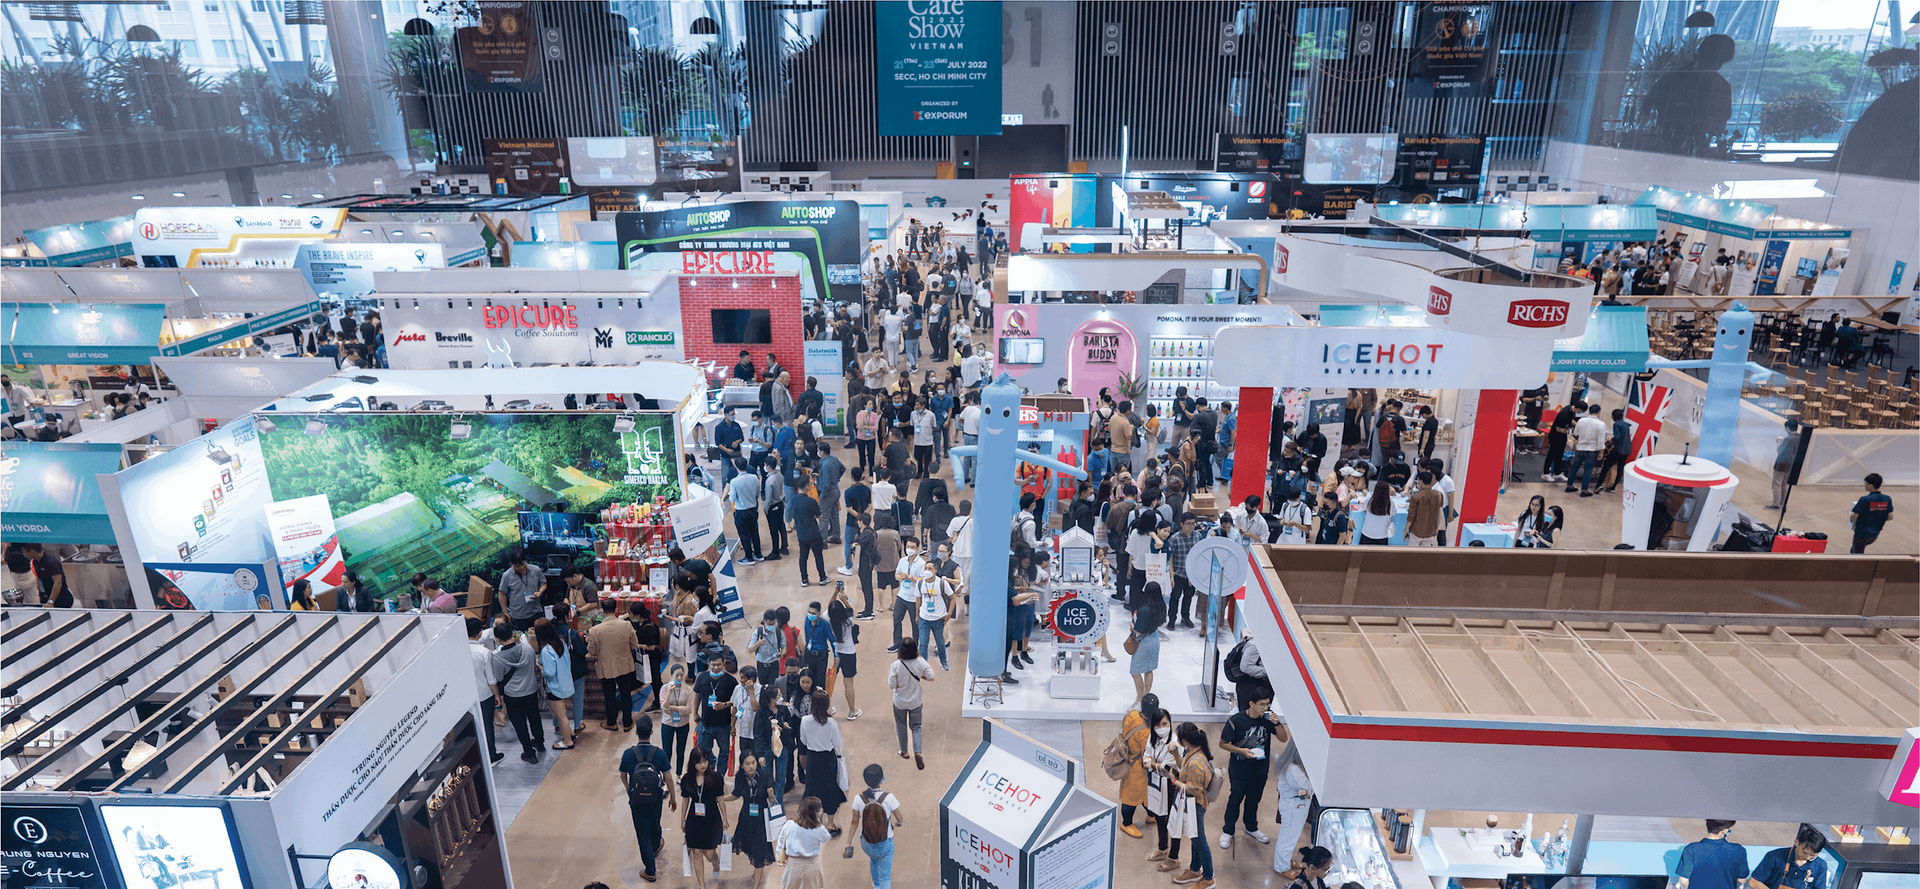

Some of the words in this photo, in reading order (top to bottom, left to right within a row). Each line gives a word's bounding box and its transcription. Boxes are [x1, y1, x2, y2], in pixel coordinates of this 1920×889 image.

[909, 16, 964, 38] Show
[948, 61, 965, 69] JULY
[894, 73, 917, 81] SECC,
[687, 209, 731, 227] AUTOSHOP
[781, 206, 836, 219] AUTOSHOP
[308, 250, 321, 261] THE
[323, 250, 345, 261] BRAVE
[346, 251, 374, 261] INSPIRE
[682, 251, 775, 274] EPICURE
[482, 305, 578, 329] EPICURE
[1512, 304, 1567, 322] RICH'S
[208, 334, 223, 342] MAULIN
[393, 330, 426, 346] jura
[435, 332, 473, 342] Breville
[514, 329, 541, 338] Coffee
[542, 328, 578, 337] Solutions
[638, 333, 673, 342] RANCILIO
[1084, 335, 1119, 347] BARISTA
[1088, 349, 1117, 360] BUDDY
[1322, 343, 1444, 364] ICEHOT
[1044, 411, 1073, 422] Mall
[234, 431, 255, 447] GOALS
[16, 525, 51, 533] YORDA
[1067, 608, 1087, 617] ICE
[1063, 617, 1090, 626] HOT
[397, 705, 418, 729] LEGEND
[358, 771, 371, 786] CHO
[413, 711, 424, 726] CHO
[980, 770, 1041, 807] ICEHOT
[955, 824, 1014, 868] ICEHOT
[37, 851, 90, 859] NGUYEN
